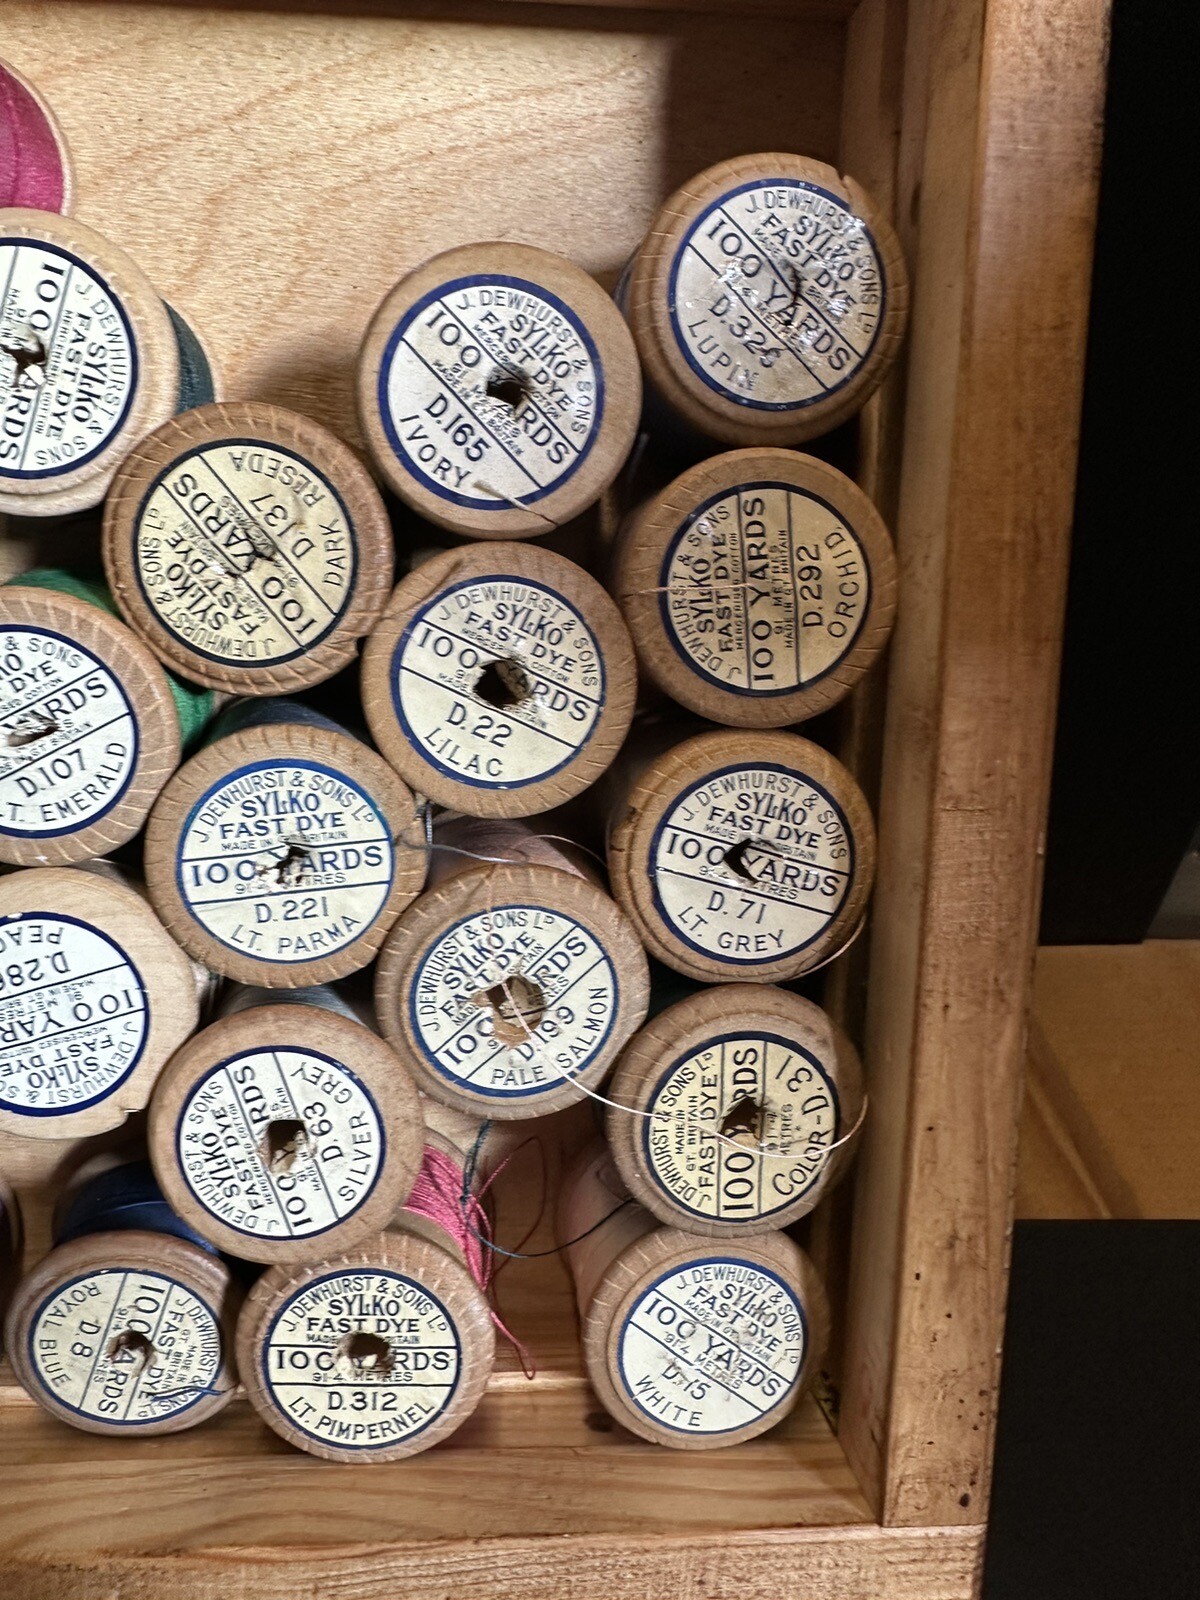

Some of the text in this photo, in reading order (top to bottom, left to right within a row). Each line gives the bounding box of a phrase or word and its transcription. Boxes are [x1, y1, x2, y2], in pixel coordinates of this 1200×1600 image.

[761, 212, 818, 269] FAST
[28, 263, 64, 331] 100
[481, 289, 581, 352] DEWHURST
[706, 218, 765, 279] 100
[764, 279, 852, 372] YARDS
[425, 310, 482, 369] 100
[479, 311, 534, 365] FAST
[532, 366, 574, 411] DYE
[509, 313, 572, 379] SYLKO
[36, 300, 127, 465] DEWHURST SONS
[46, 313, 90, 438] FAST DYE
[72, 342, 107, 422] SYLKO
[400, 415, 471, 488] IVORY
[424, 392, 491, 462] D.165
[228, 451, 324, 507] RESEDA
[164, 530, 209, 575] DYE
[249, 493, 315, 559] D.137
[319, 518, 340, 586] DARK
[142, 536, 162, 587] SONS
[672, 505, 729, 670] DEWHURST SONS
[743, 498, 774, 680] 100 YARDS
[796, 544, 823, 626] D.292
[824, 532, 858, 637] ORCHID
[166, 562, 228, 631] SYLKO
[205, 579, 260, 634] FAST
[261, 576, 316, 635] 100
[689, 558, 713, 632] SYLKO
[712, 533, 732, 651] FAST DYE
[29, 637, 81, 666] SONS
[418, 627, 480, 670] 100
[456, 586, 597, 686] DEWHURST SONS
[464, 610, 577, 673] FAST DYE
[492, 602, 564, 646] SYLKO
[8, 660, 57, 693] DYE
[445, 700, 513, 748] D.22
[14, 748, 86, 797] D.107
[424, 728, 500, 777] LILAC
[39, 742, 124, 822] EMERALD
[199, 770, 357, 825] DEWHURST & SONS
[241, 789, 319, 817] SYLKO
[734, 791, 807, 825] SYLKO
[219, 812, 343, 838] FAST DYE
[696, 775, 845, 859] DEWHURST & SONS
[708, 806, 821, 848] FAST DYE
[191, 859, 256, 886] 100
[666, 833, 725, 866] 100
[254, 896, 328, 923] D.221
[278, 915, 360, 953] PARMA
[463, 924, 480, 940] &
[480, 912, 527, 932] SONS
[707, 890, 765, 923] D.71
[442, 932, 504, 990] SYLKO
[494, 931, 535, 969] DYE
[720, 929, 782, 952] GREY
[72, 988, 134, 1022] 100
[0, 1034, 113, 1077] FAST DYE
[491, 987, 606, 1086] PALE SALMON
[27, 1056, 100, 1090] SYLKO
[46, 1041, 133, 1105] DEWHURST
[661, 1067, 695, 1106] SONS
[290, 1061, 372, 1199] SILVER GREY
[303, 1101, 343, 1163] D.63
[674, 1124, 685, 1154] MADE
[686, 1095, 697, 1144] BRITAIN
[699, 1075, 716, 1186] FAST DYE
[185, 1081, 258, 1227] DEWHURST & SONS
[201, 1132, 241, 1199] SYLKO
[210, 1106, 265, 1211] FAST DYE
[652, 1126, 696, 1200] DEWHURST
[724, 1152, 754, 1209] 100
[276, 1172, 312, 1228] 100
[126, 1284, 164, 1334] 100
[290, 1277, 434, 1317] DEWHURST & SONS
[329, 1294, 399, 1315] SYLKO
[691, 1285, 782, 1352] FAST DYE
[693, 1268, 799, 1341] DEWHURST & SONS
[719, 1283, 779, 1328] SYLKO
[39, 1282, 100, 1386] ROYAL BLUE
[70, 1320, 100, 1358] D.8
[154, 1310, 183, 1360] FAST
[187, 1305, 215, 1376] DEWHURST
[306, 1318, 418, 1333] FAST DYE
[644, 1297, 782, 1397] 100 YARDS
[277, 1349, 333, 1369] 100
[314, 1402, 434, 1439] PIMPERNEL
[328, 1392, 397, 1410] D.312
[635, 1374, 702, 1427] WHITE
